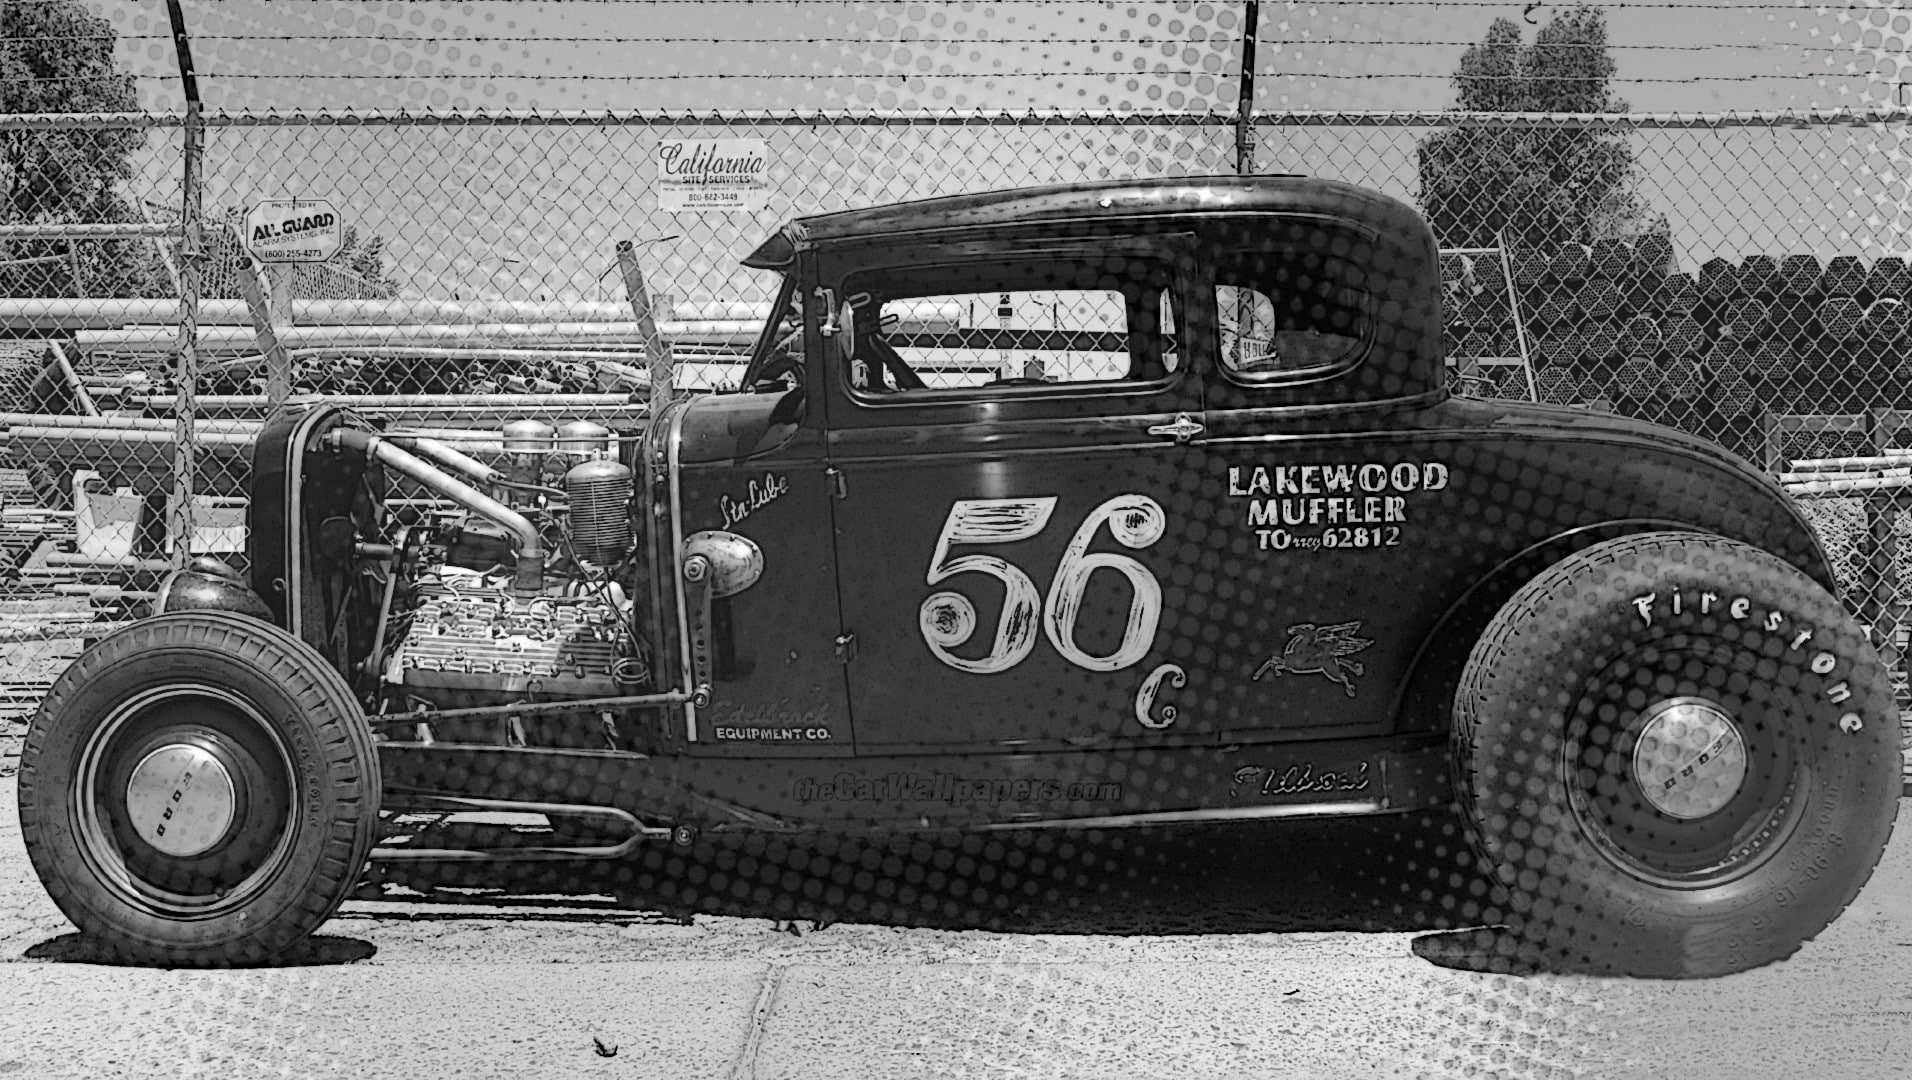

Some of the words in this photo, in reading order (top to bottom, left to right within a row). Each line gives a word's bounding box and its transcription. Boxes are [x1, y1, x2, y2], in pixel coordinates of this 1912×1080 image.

[660, 142, 766, 185] California
[682, 175, 701, 184] SITE
[709, 175, 751, 184] SERVICES
[282, 213, 334, 234] GUARD
[1228, 462, 1448, 496] LAKEWOOD
[1248, 496, 1407, 526] MUFFLER
[1322, 526, 1400, 548] 62812
[919, 494, 1166, 673] 56
[1632, 586, 1863, 734] Firestone
[716, 727, 802, 740] EQUIPMENT
[805, 727, 832, 740] CO.
[1664, 739, 1722, 790] FORD
[156, 771, 192, 837] FORD
